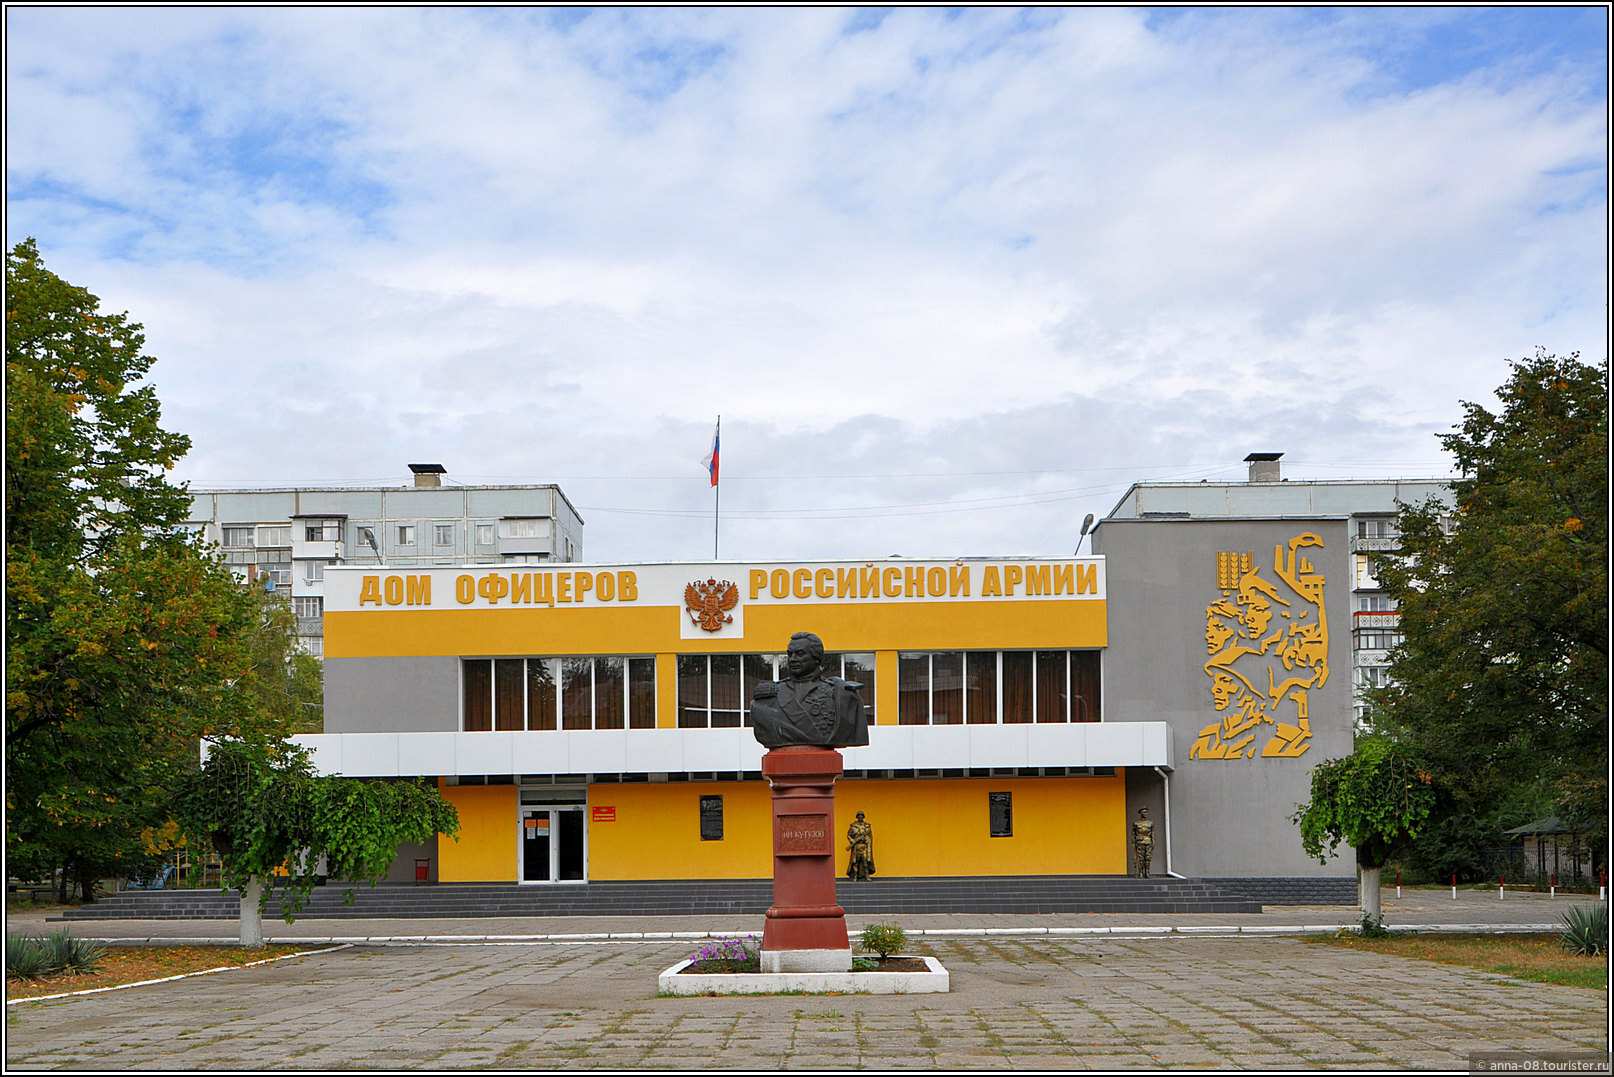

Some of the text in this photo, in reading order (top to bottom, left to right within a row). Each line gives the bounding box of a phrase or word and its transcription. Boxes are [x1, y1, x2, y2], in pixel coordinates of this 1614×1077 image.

[359, 562, 1098, 608] ДОМ ОФИЦЕРОВ РОССИЙСКОЙ АРМИИ
